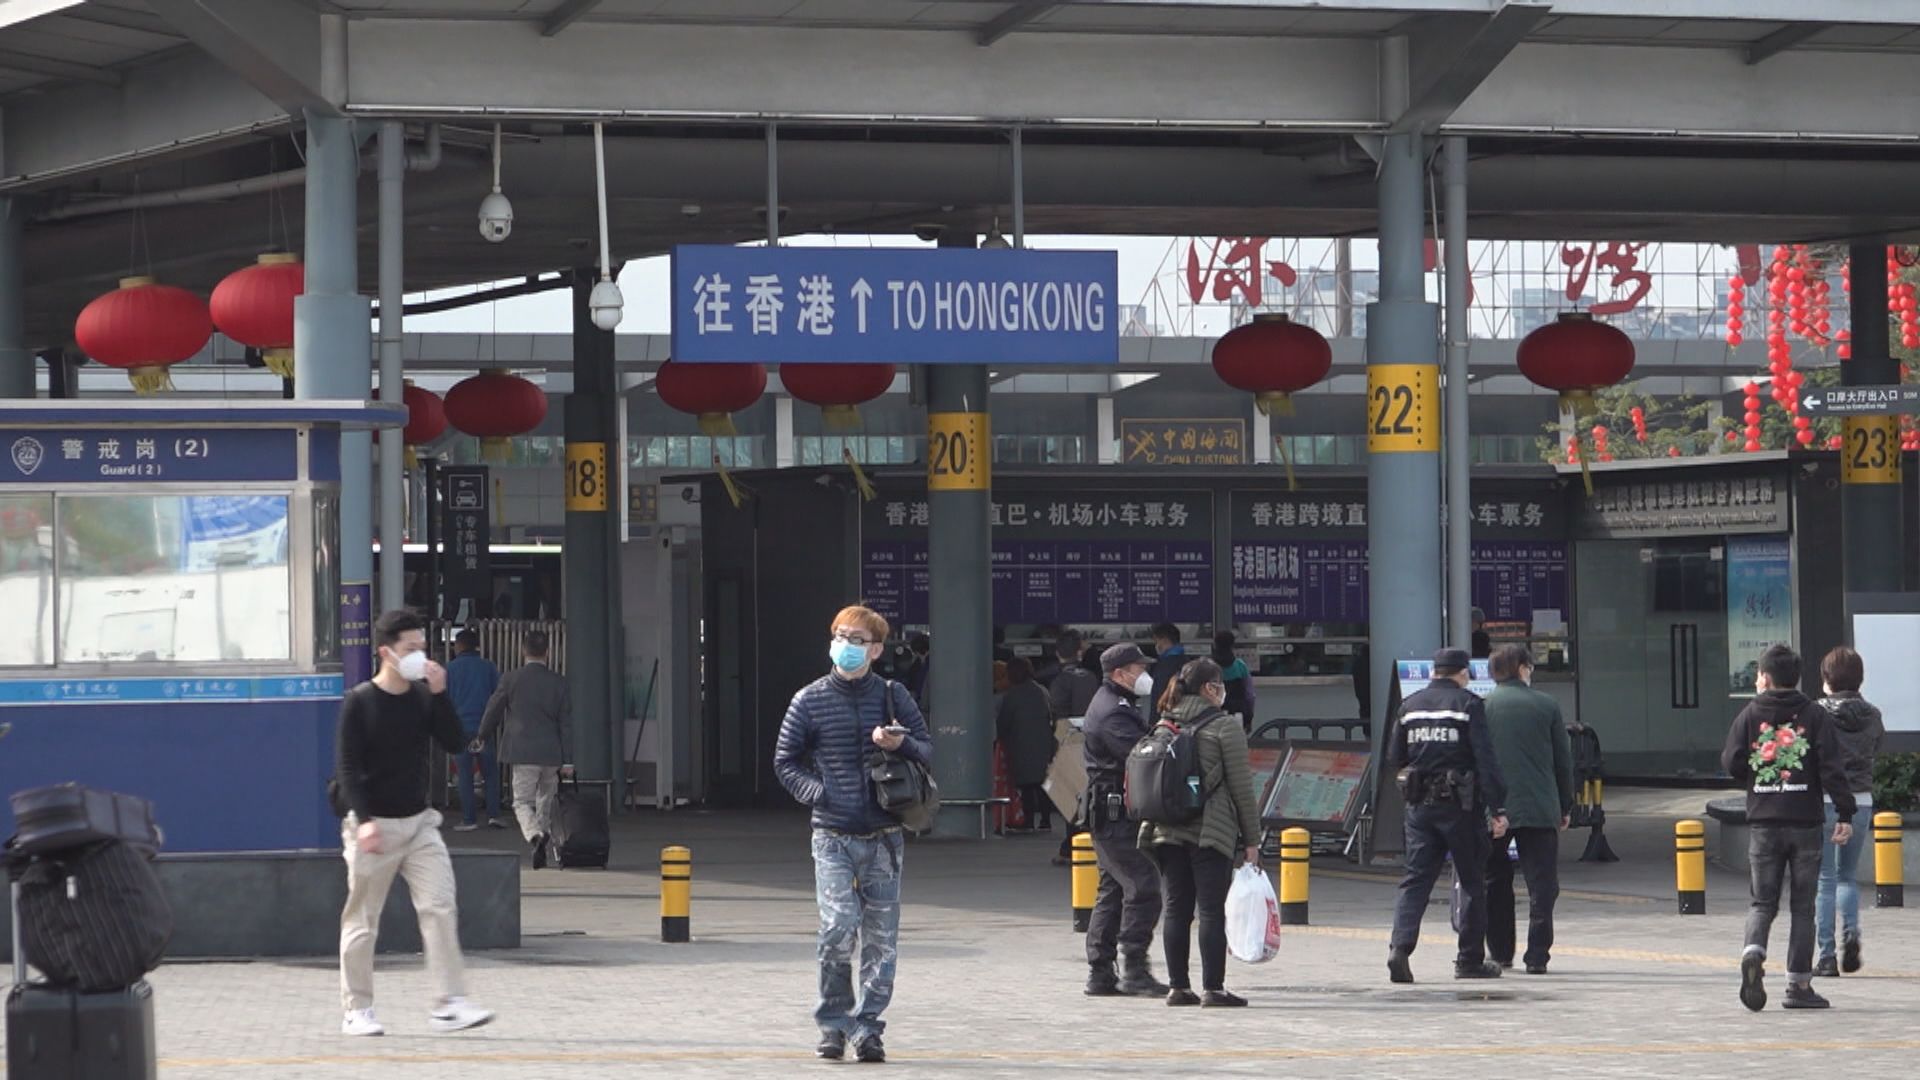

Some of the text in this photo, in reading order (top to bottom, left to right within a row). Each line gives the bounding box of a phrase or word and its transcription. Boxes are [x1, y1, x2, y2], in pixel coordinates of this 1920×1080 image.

[692, 273, 836, 336] 往香港
[887, 281, 1106, 332] TO HONGKONG
[1375, 385, 1413, 435] 22
[1826, 390, 1898, 403] 口岸大厅出入口
[62, 438, 209, 460] 警戒岗 (2)
[934, 432, 967, 474] 20
[1163, 427, 1238, 450] 中国海关
[1852, 427, 1887, 469] 23
[100, 464, 136, 475] Guard
[1163, 454, 1239, 465] CHINA CUSTOMS
[568, 460, 596, 498] 18
[1233, 546, 1299, 579] 香港国际机场
[1415, 727, 1448, 742] POLICE
